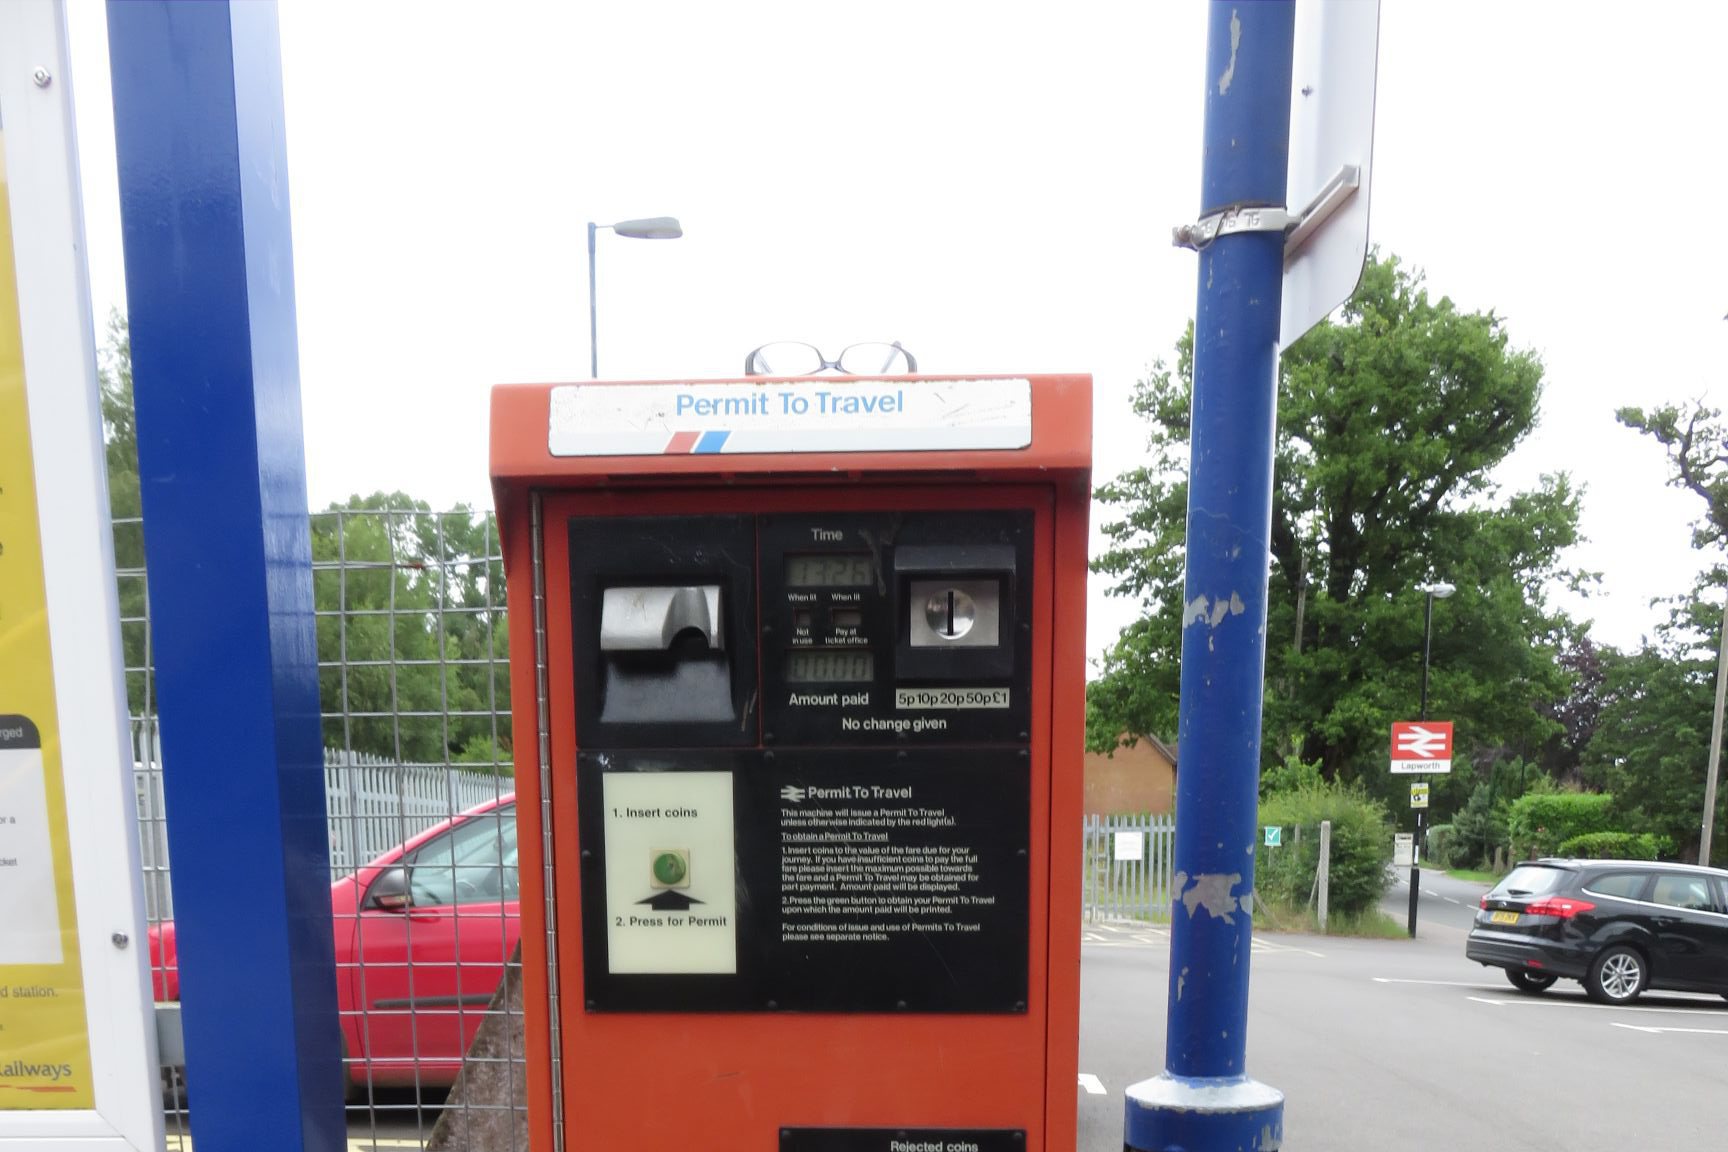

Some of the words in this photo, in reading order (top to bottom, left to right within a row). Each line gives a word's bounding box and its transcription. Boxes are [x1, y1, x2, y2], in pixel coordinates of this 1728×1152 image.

[676, 393, 769, 416] Permit
[778, 392, 808, 415] To
[815, 390, 903, 414] Travel
[811, 528, 843, 541] Time
[788, 593, 809, 602] When
[809, 593, 817, 602] lit
[831, 593, 852, 602] When
[853, 593, 861, 602] lit
[796, 628, 809, 636] Not
[835, 628, 849, 638] Pay
[849, 628, 857, 636] at
[792, 637, 800, 645] in
[825, 637, 847, 645] ticket
[847, 637, 869, 645] office
[788, 692, 838, 706] Amount
[842, 692, 869, 708] paid
[898, 692, 915, 707] 5p
[917, 692, 939, 707] 10p
[940, 692, 965, 706] 20p
[966, 692, 992, 706] 50p
[993, 692, 1007, 704] £1
[842, 718, 860, 730] No
[863, 718, 911, 732] change
[913, 717, 947, 732] given
[1401, 761, 1441, 770] Lapworth
[808, 786, 852, 799] Permit
[852, 786, 869, 799] To
[871, 785, 912, 799] Travel
[612, 808, 623, 818] 1.
[626, 808, 661, 818] Insert
[664, 807, 698, 818] coins
[781, 808, 798, 817] This
[799, 808, 833, 817] machine
[835, 808, 849, 817] will
[850, 808, 871, 817] issue
[880, 808, 906, 817] Permit
[908, 808, 918, 817] To
[919, 808, 945, 817] Travel
[781, 817, 807, 826] unless
[807, 817, 847, 826] otherwise
[849, 817, 886, 826] indicated
[887, 817, 896, 828] by
[898, 817, 911, 826] the
[912, 817, 926, 826] red
[927, 817, 956, 828] light(s).
[781, 832, 792, 841] To
[793, 832, 818, 841] obtain
[825, 832, 851, 841] Permit
[853, 832, 862, 841] To
[863, 832, 888, 841] Travel
[812, 846, 834, 854] coins
[835, 846, 843, 854] to
[844, 846, 858, 854] the
[858, 846, 880, 854] value
[881, 846, 890, 854] of
[891, 846, 904, 854] the
[905, 846, 921, 854] fare
[922, 846, 937, 854] due
[939, 846, 951, 854] for
[951, 848, 970, 856] your
[781, 855, 813, 865] journey.
[821, 857, 837, 865] you
[837, 855, 857, 864] have
[857, 855, 901, 864] insufficient
[902, 855, 924, 864] coins
[925, 855, 933, 864] to
[934, 857, 949, 865] pay
[950, 855, 964, 864] the
[965, 855, 978, 864] full
[781, 864, 798, 873] fare
[798, 864, 825, 874] please
[826, 864, 850, 873] insert
[850, 864, 864, 873] the
[865, 864, 904, 873] maximum
[905, 864, 939, 874] possible
[940, 864, 973, 873] towards
[782, 873, 795, 881] the
[796, 873, 812, 881] fare
[813, 873, 829, 881] and
[836, 873, 863, 881] Permit
[863, 873, 874, 881] To
[875, 873, 899, 881] Travel
[900, 875, 917, 883] may
[919, 873, 930, 881] be
[931, 873, 967, 881] obtained
[967, 873, 979, 881] for
[781, 882, 799, 892] part
[800, 882, 837, 892] payment.
[840, 882, 872, 891] Amount
[873, 882, 891, 892] paid
[892, 882, 907, 891] will
[908, 882, 918, 891] be
[919, 882, 960, 892] displayed.
[813, 896, 827, 905] the
[826, 898, 850, 907] green
[851, 896, 878, 905] button
[878, 896, 887, 905] to
[887, 896, 913, 905] obtain
[913, 898, 931, 907] your
[932, 896, 959, 905] Permit
[960, 896, 970, 905] To
[971, 896, 995, 905] Travel
[782, 907, 802, 915] upon
[803, 905, 828, 914] which
[829, 905, 841, 914] the
[842, 905, 873, 914] amount
[875, 905, 892, 915] paid
[893, 905, 908, 914] will
[908, 905, 920, 914] be
[921, 905, 953, 915] printed.
[615, 916, 626, 927] 2.
[629, 916, 663, 927] Press
[667, 916, 684, 927] for
[688, 916, 727, 927] Permit
[782, 923, 796, 932] For
[796, 923, 837, 932] conditions
[838, 923, 848, 932] of
[848, 923, 869, 932] issue
[870, 923, 886, 932] and
[902, 923, 911, 932] of
[912, 923, 942, 932] Permits
[944, 923, 954, 932] To
[956, 923, 980, 932] Travel
[782, 933, 809, 943] please
[826, 933, 861, 943] separate
[862, 933, 890, 941] notice.
[12, 986, 59, 998] station.
[946, 1141, 979, 1152] coins
